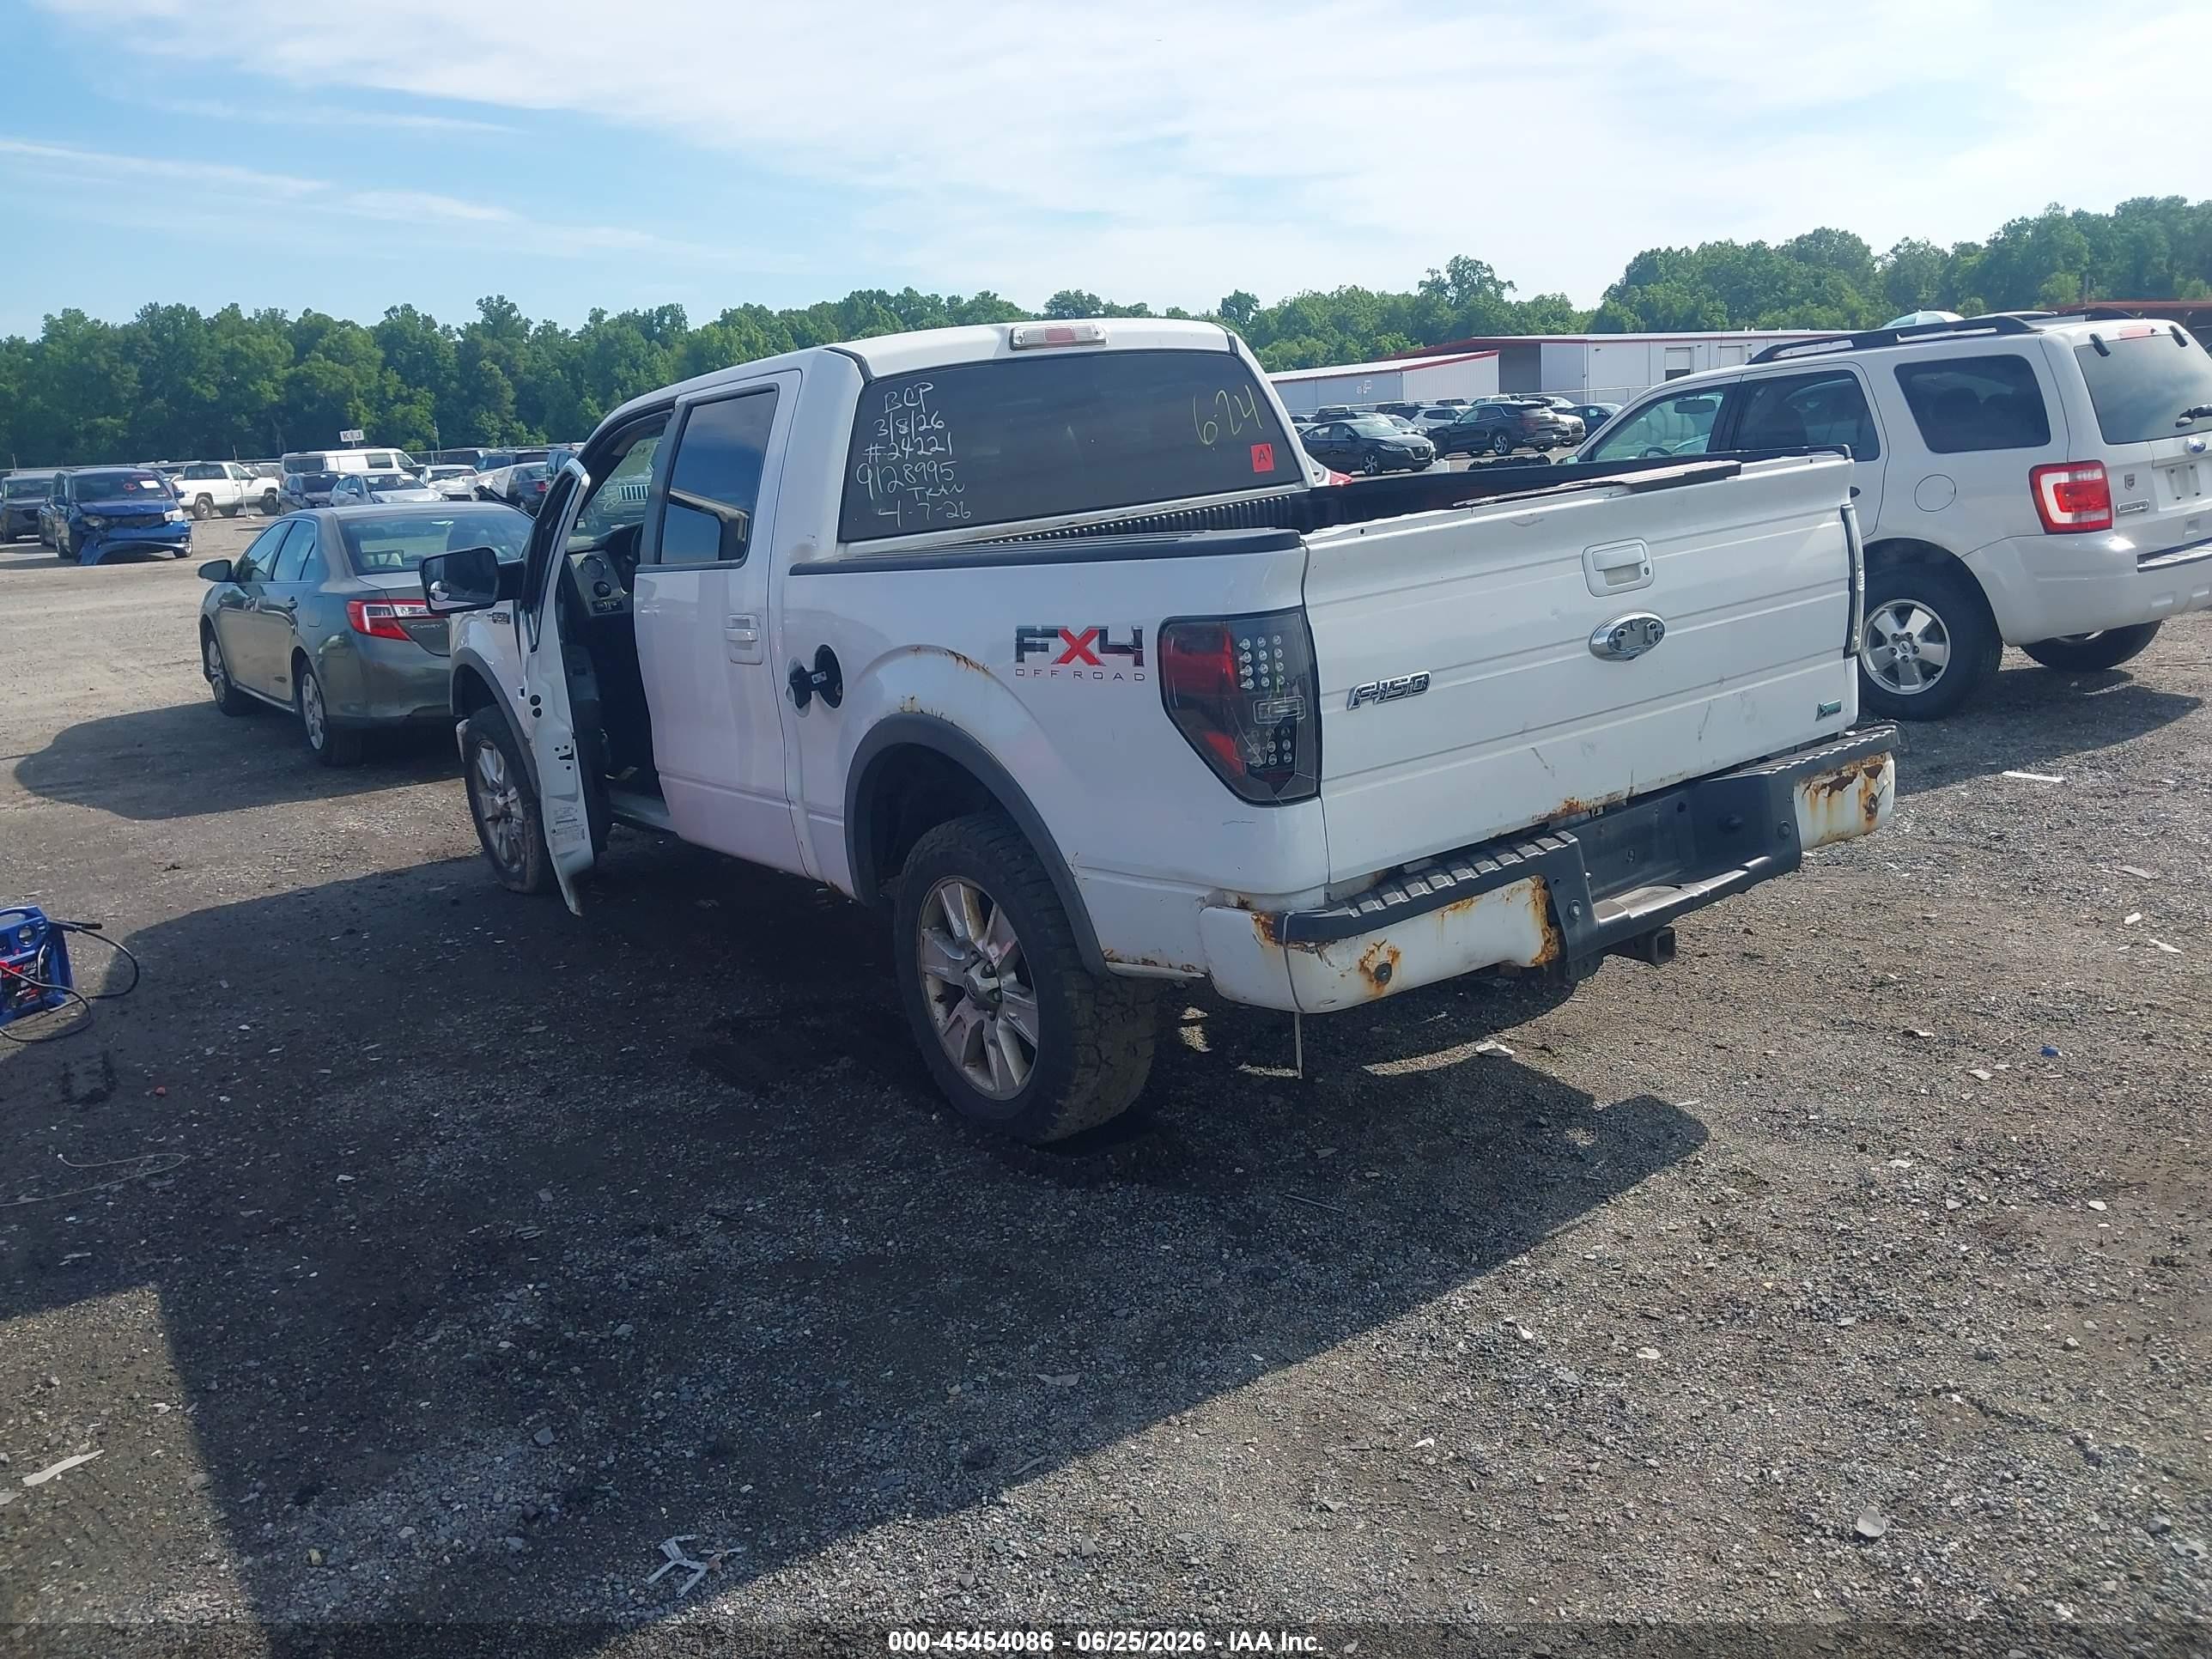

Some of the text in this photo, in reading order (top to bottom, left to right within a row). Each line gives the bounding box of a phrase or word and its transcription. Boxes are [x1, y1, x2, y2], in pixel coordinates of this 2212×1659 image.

[1193, 384, 1263, 446] 624
[1257, 449, 1267, 463] A
[1016, 625, 1145, 667] FX4
